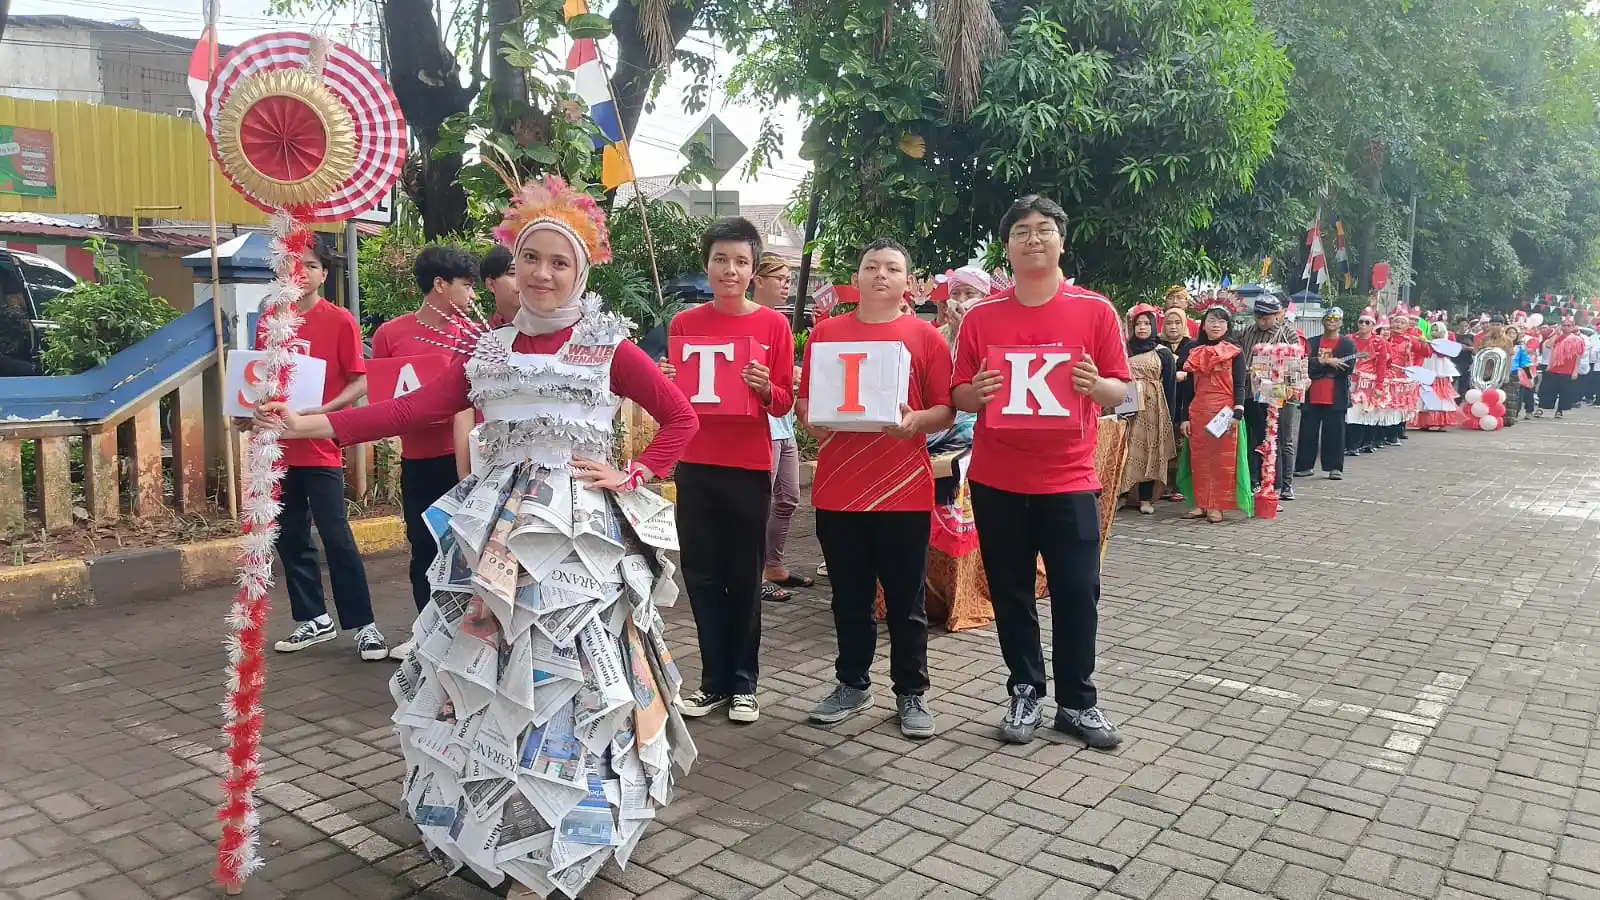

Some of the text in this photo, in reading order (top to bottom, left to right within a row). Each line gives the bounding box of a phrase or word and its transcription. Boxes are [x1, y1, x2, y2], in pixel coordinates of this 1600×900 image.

[820, 291, 834, 307] 17
[562, 354, 609, 364] MENANG
[569, 344, 615, 356] WAJIB
[394, 363, 422, 398] A
[682, 343, 734, 403] T
[837, 353, 868, 412] I
[1002, 353, 1071, 416] K
[596, 657, 612, 687] Pansus
